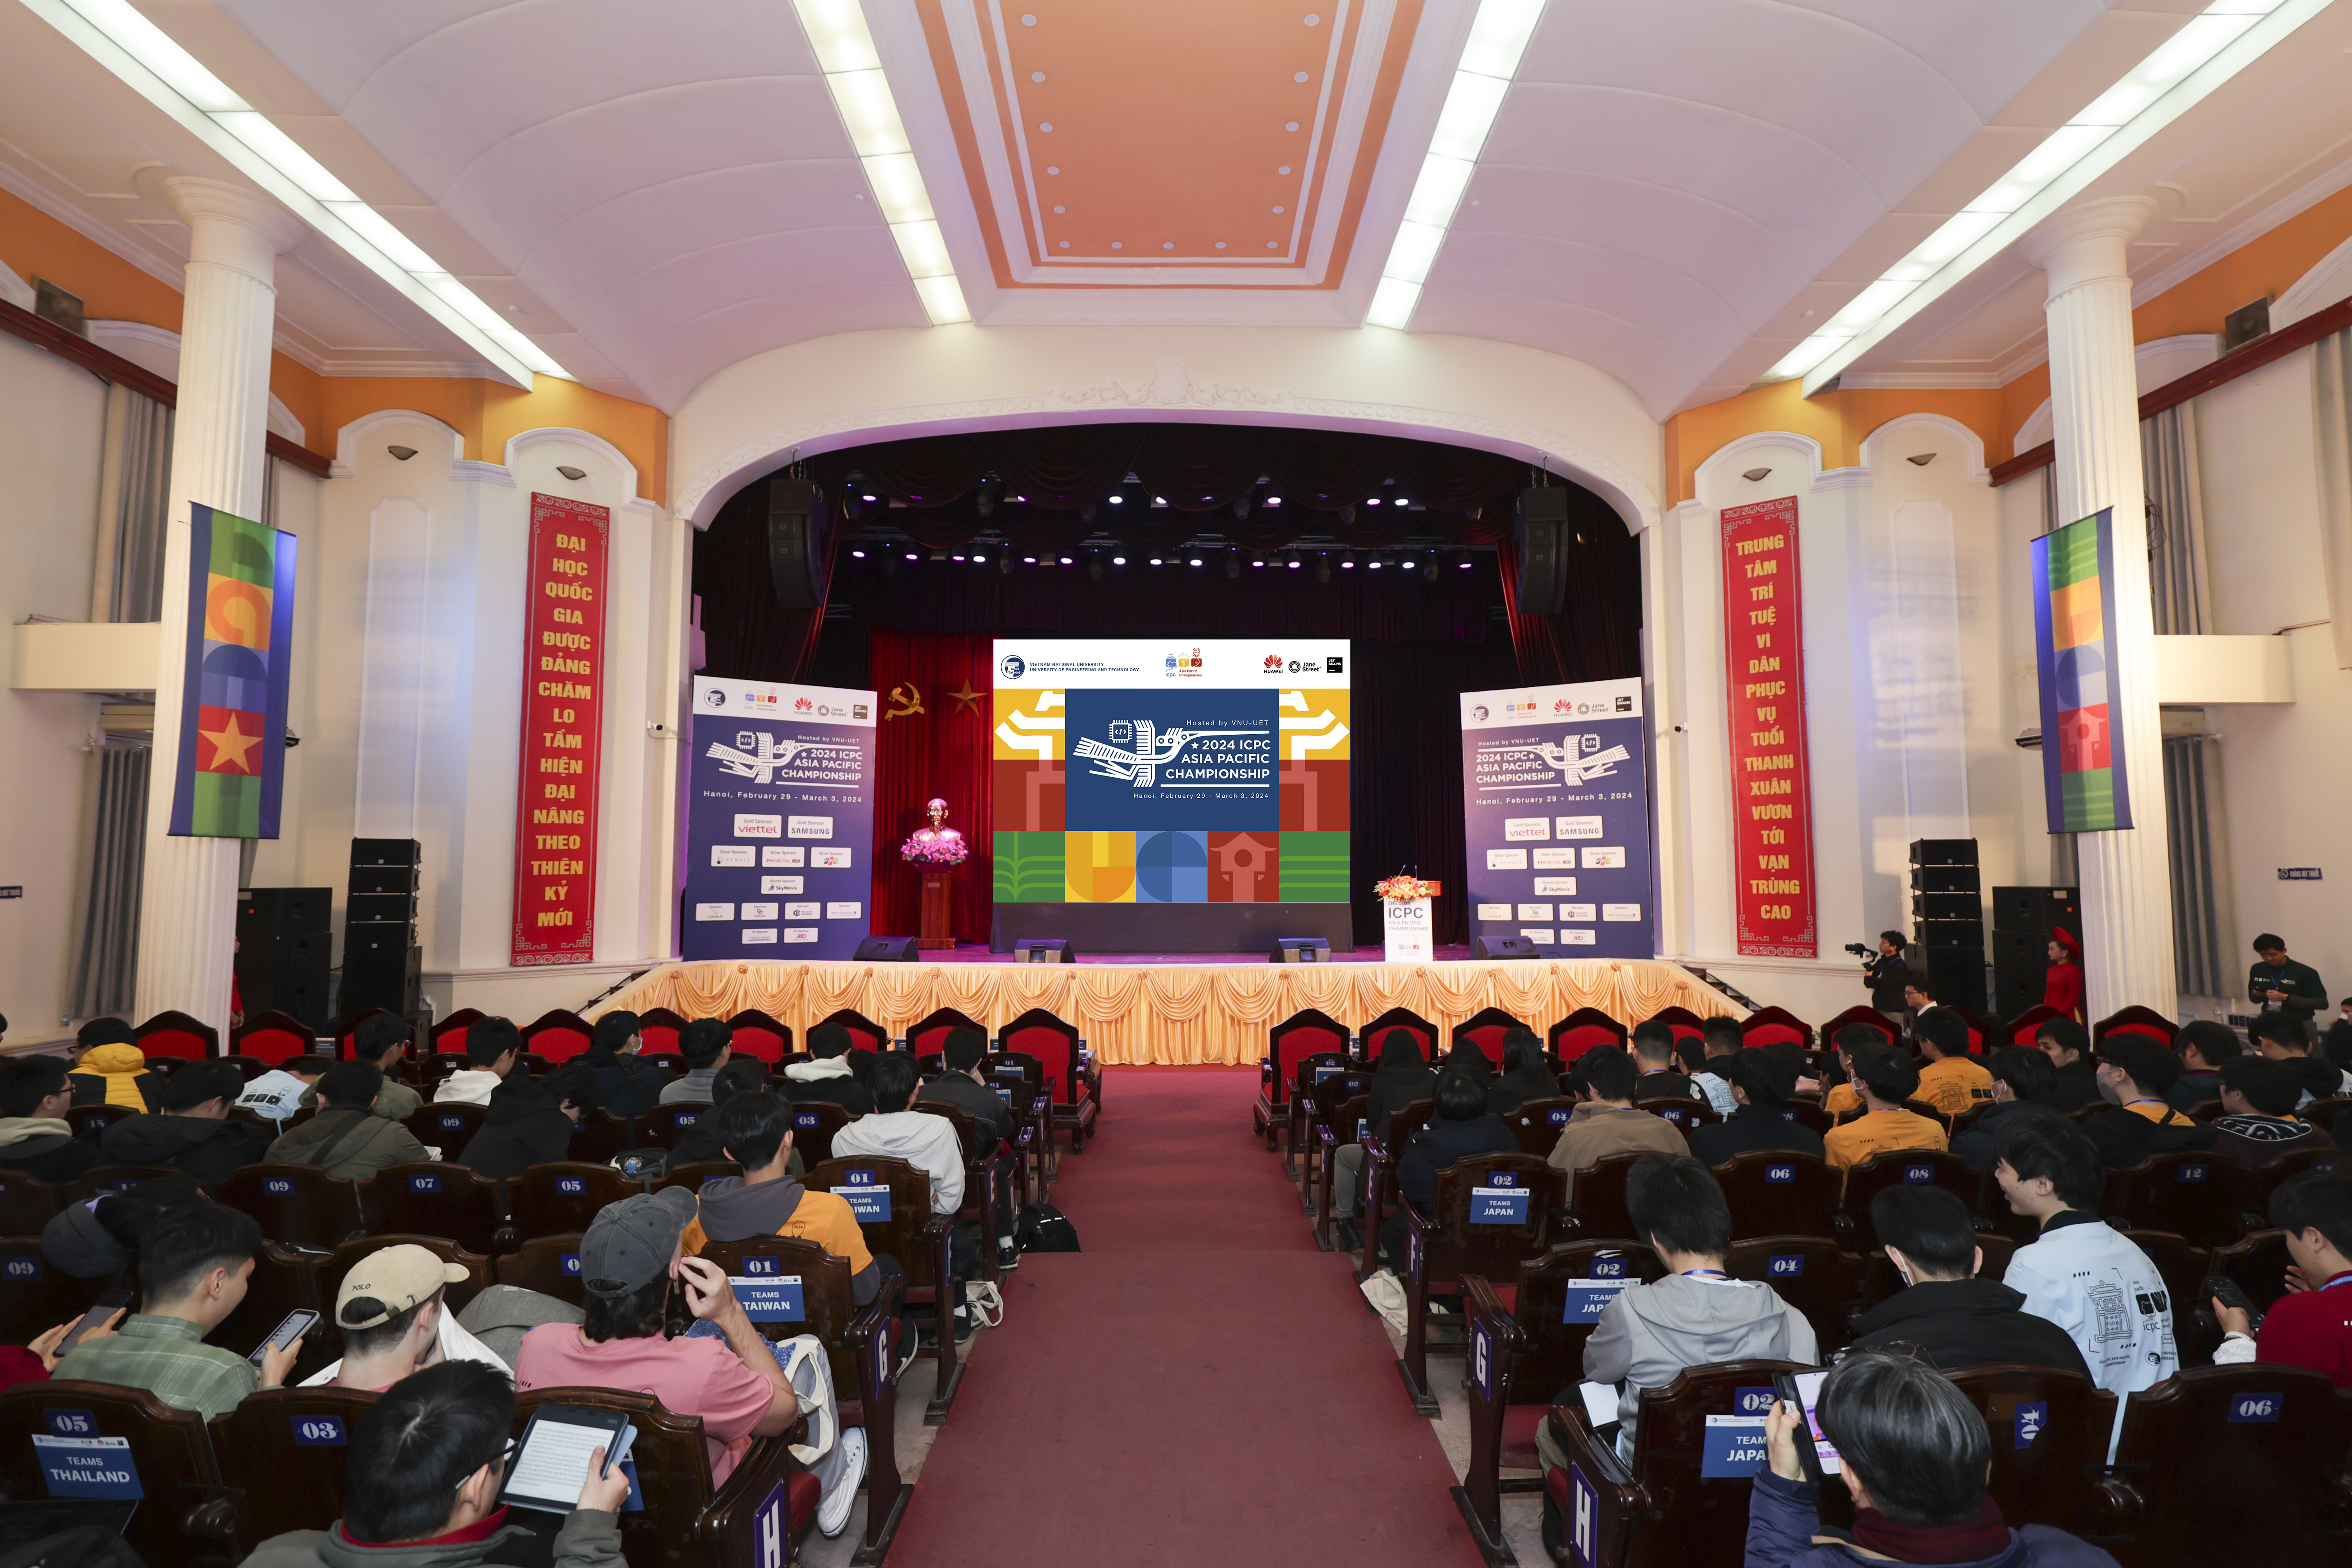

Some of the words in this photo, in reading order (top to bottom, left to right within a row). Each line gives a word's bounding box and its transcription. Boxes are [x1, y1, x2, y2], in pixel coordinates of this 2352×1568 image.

[556, 534, 585, 553] ĐẠI
[1736, 535, 1784, 556] TRUNG
[553, 558, 588, 576] HỌC
[1745, 560, 1776, 578] TÂM
[546, 582, 592, 601] QUỐC
[1750, 582, 1773, 601] TRÍ
[554, 608, 583, 624] GIA
[1749, 606, 1776, 625] TUỆ
[543, 632, 590, 651] ĐƯỢC
[1756, 632, 1770, 648] VÌ
[541, 652, 590, 674] ĐẢNG
[1749, 656, 1780, 673] DÂN
[539, 681, 591, 699] CHĂM
[1746, 681, 1785, 699] PHỤC
[553, 709, 574, 723] LO
[1757, 706, 1776, 723] VỤ
[543, 729, 582, 749] TẦM
[1751, 725, 1784, 746] TUỔI
[1202, 740, 1235, 750] 2024
[1240, 740, 1271, 750] ICPC
[811, 749, 836, 758] 2024
[840, 751, 863, 759] ICPC
[1181, 754, 1213, 763] ASIA
[1217, 754, 1269, 763] PACIFIC
[1476, 753, 1501, 762] 2024
[1504, 752, 1527, 760] ICPC
[540, 756, 582, 776] HIỆN
[794, 759, 819, 767] ASIA
[822, 760, 861, 769] PACIFIC
[1476, 763, 1500, 772] ASIA
[1503, 761, 1542, 770] PACIFIC
[1744, 755, 1793, 771] THANH
[782, 769, 861, 780] CHAMPIONSHIP
[1166, 769, 1270, 779] CHAMPIONSHIP
[1476, 772, 1555, 783] CHAMPIONSHIP
[545, 784, 575, 801] ĐẠI
[1750, 778, 1791, 795] XUÂN
[738, 792, 777, 800] February
[534, 807, 584, 824] NÂNG
[1752, 804, 1792, 820] VƯƠN
[738, 825, 777, 833] viettel
[1761, 826, 1784, 844] TỚI
[536, 836, 580, 849] THEO
[531, 858, 583, 875] THIÊN
[1759, 855, 1789, 872] VẠN
[545, 880, 568, 900] KỶ
[1750, 877, 1799, 894] TRÙNG
[537, 907, 573, 926] MỚI
[1389, 908, 1423, 918] ICPC
[1761, 904, 1791, 920] CAO
[1551, 1112, 1568, 1121] 04
[1664, 1111, 1680, 1120] 06
[851, 1173, 869, 1183] 01
[1494, 1176, 1512, 1185] 02
[1771, 1169, 1789, 1178] 06
[1910, 1169, 1928, 1178] 08
[2185, 1169, 2201, 1178] 12
[270, 1182, 289, 1191] 09
[416, 1178, 433, 1188] 07
[562, 1181, 580, 1190] 05
[991, 1170, 994, 1202] E
[1369, 1167, 1373, 1200] E
[948, 1235, 951, 1276] F
[1411, 1234, 1416, 1271] F
[9, 1262, 33, 1274] 09
[750, 1261, 773, 1272] 01
[1597, 1264, 1619, 1275] 02
[1775, 1260, 1797, 1272] 04
[743, 1302, 790, 1310] TAIWAN
[2143, 1322, 2161, 1332] icpc
[879, 1330, 887, 1382] G
[1476, 1332, 1486, 1387] G
[1743, 1394, 1776, 1411] 02
[2240, 1401, 2271, 1416] 06
[57, 1416, 88, 1431] 05
[303, 1423, 337, 1438] 03
[2021, 1408, 2039, 1440] 04
[67, 1457, 103, 1466] TEAMS
[1726, 1450, 1766, 1461] JAPA
[50, 1469, 130, 1482] THAILAND
[1576, 1480, 1590, 1561] H
[763, 1500, 780, 1568] H
